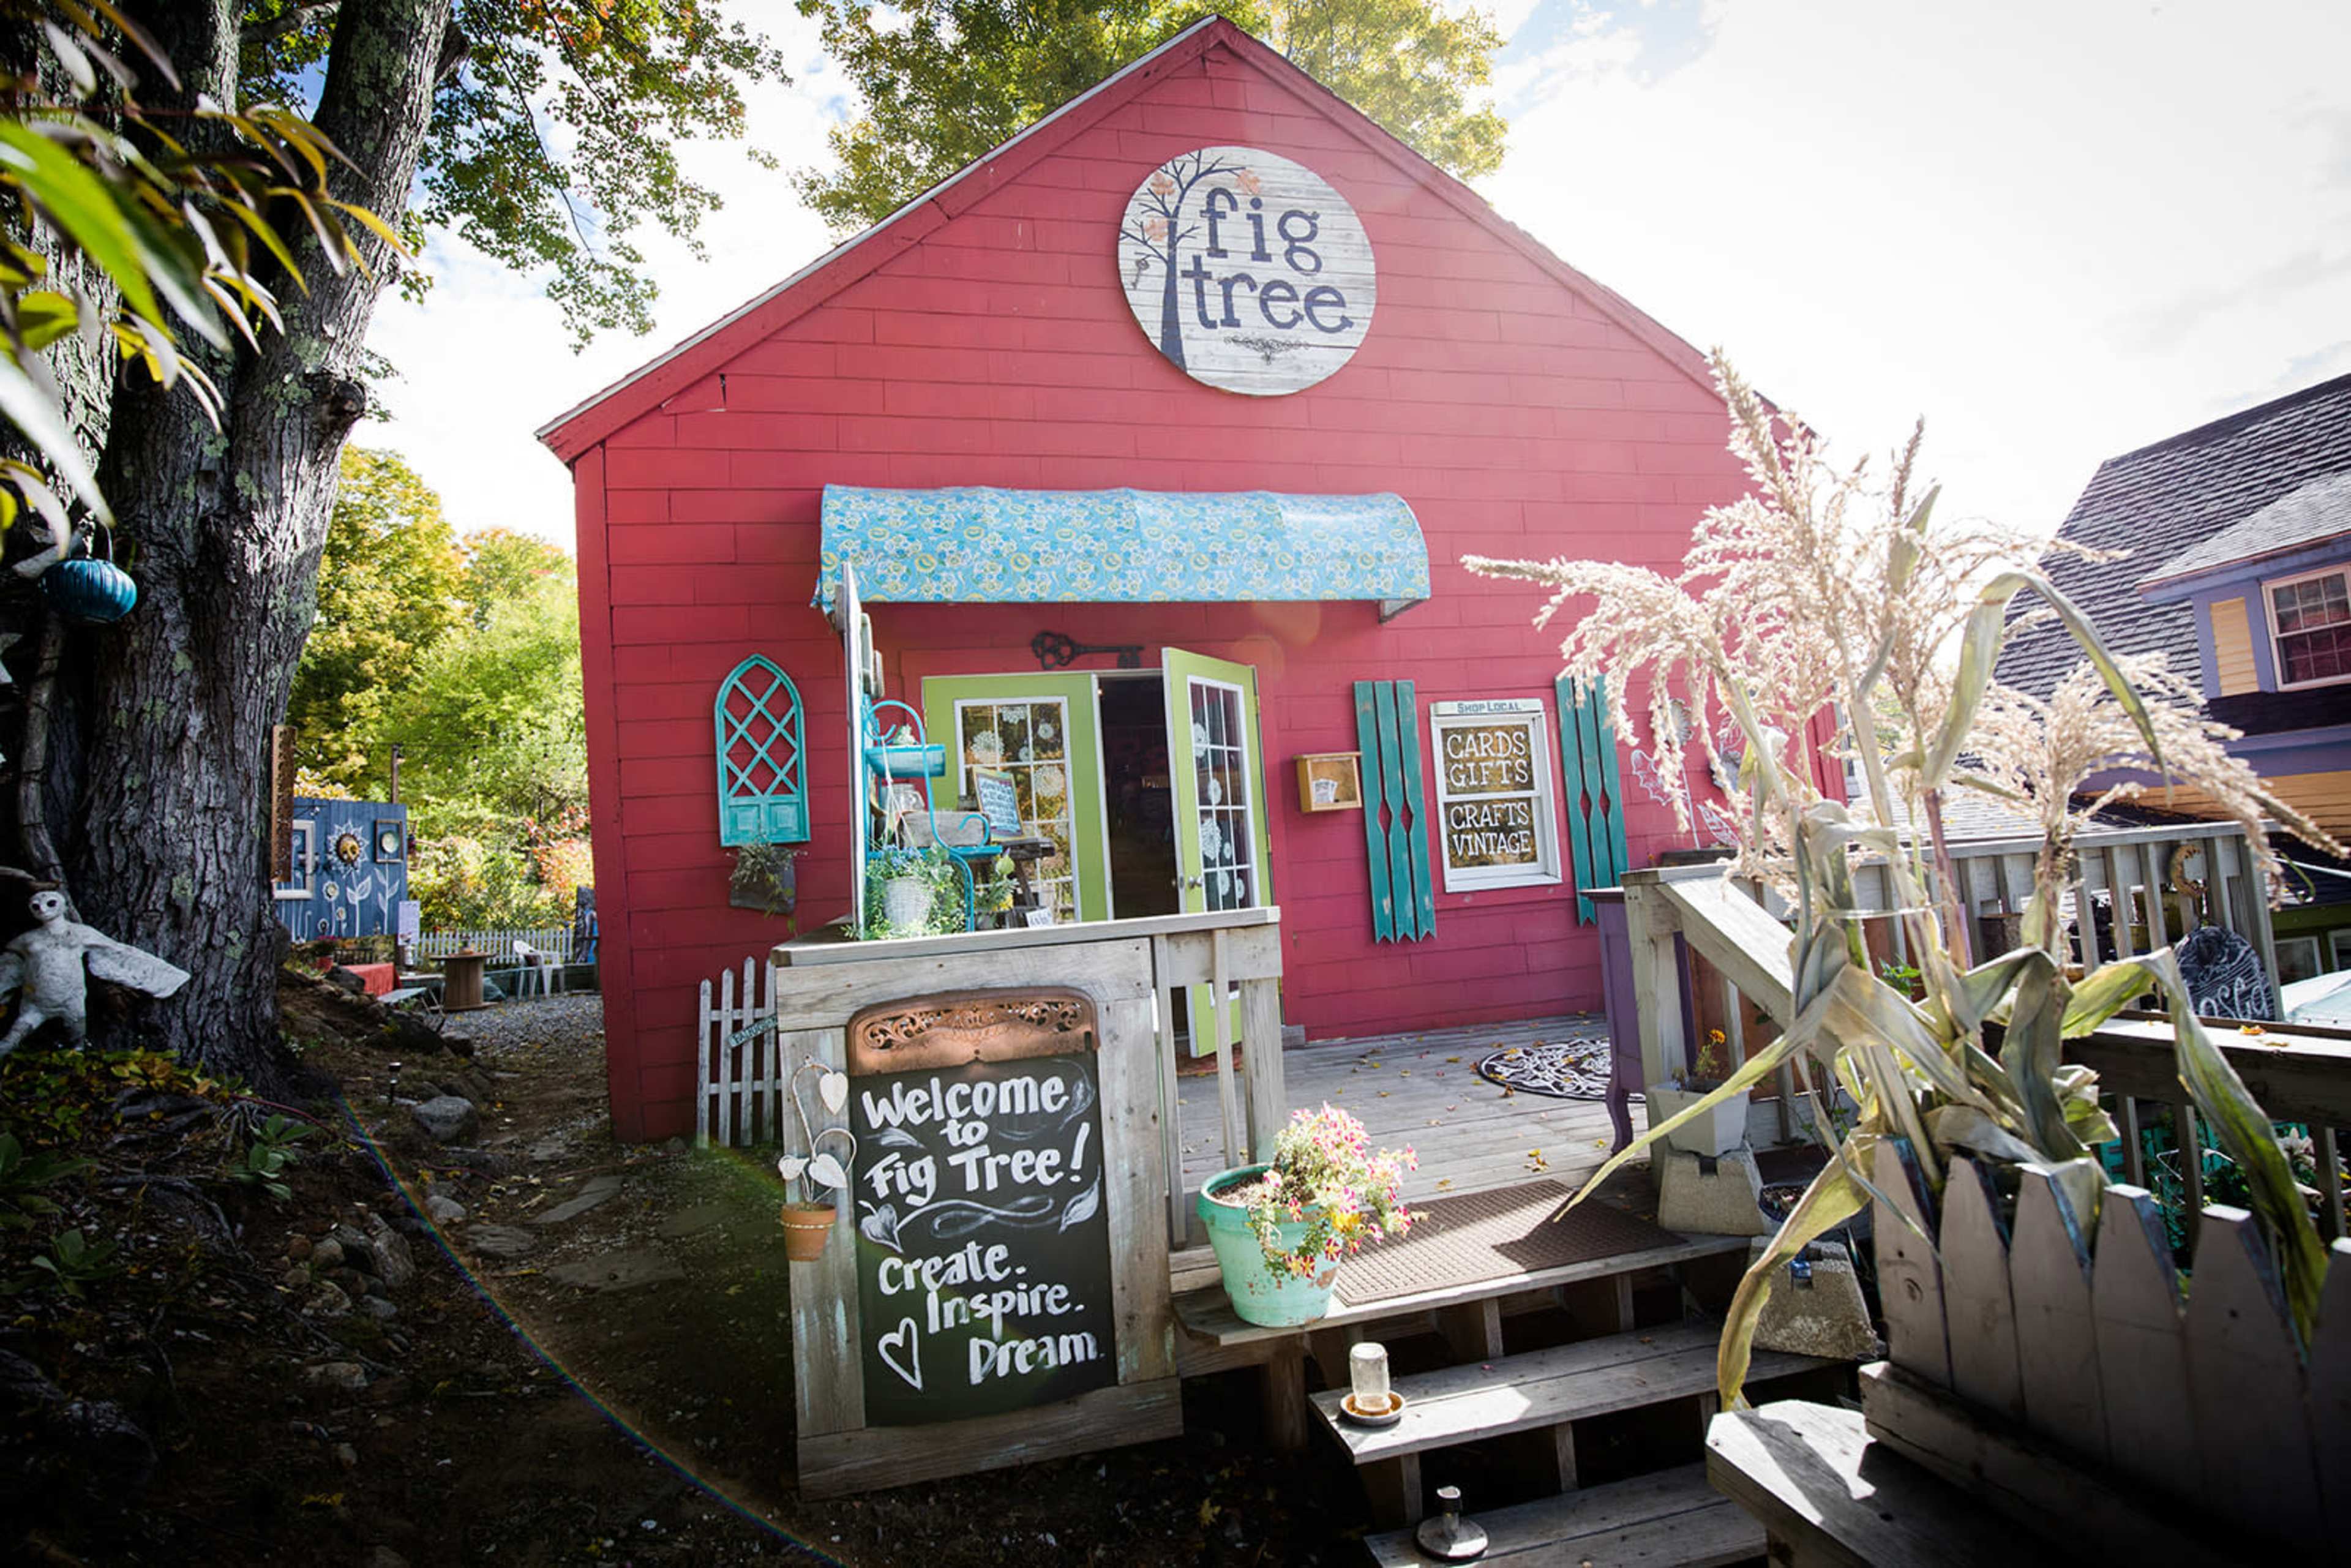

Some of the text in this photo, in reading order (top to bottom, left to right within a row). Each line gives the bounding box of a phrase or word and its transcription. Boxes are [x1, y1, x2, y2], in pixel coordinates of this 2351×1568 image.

[1200, 187, 1322, 276] fig
[1181, 255, 1354, 334] tree
[1447, 731, 1527, 759] CARDS
[1449, 759, 1529, 787] GIFTS
[1450, 801, 1529, 829] CRAFTS
[1452, 830, 1531, 856] VINTAGE
[861, 1075, 1070, 1130] Welcome
[939, 1119, 989, 1147] to
[864, 1122, 1090, 1206] Fig Tree!
[927, 1282, 1085, 1341] Inspire.
